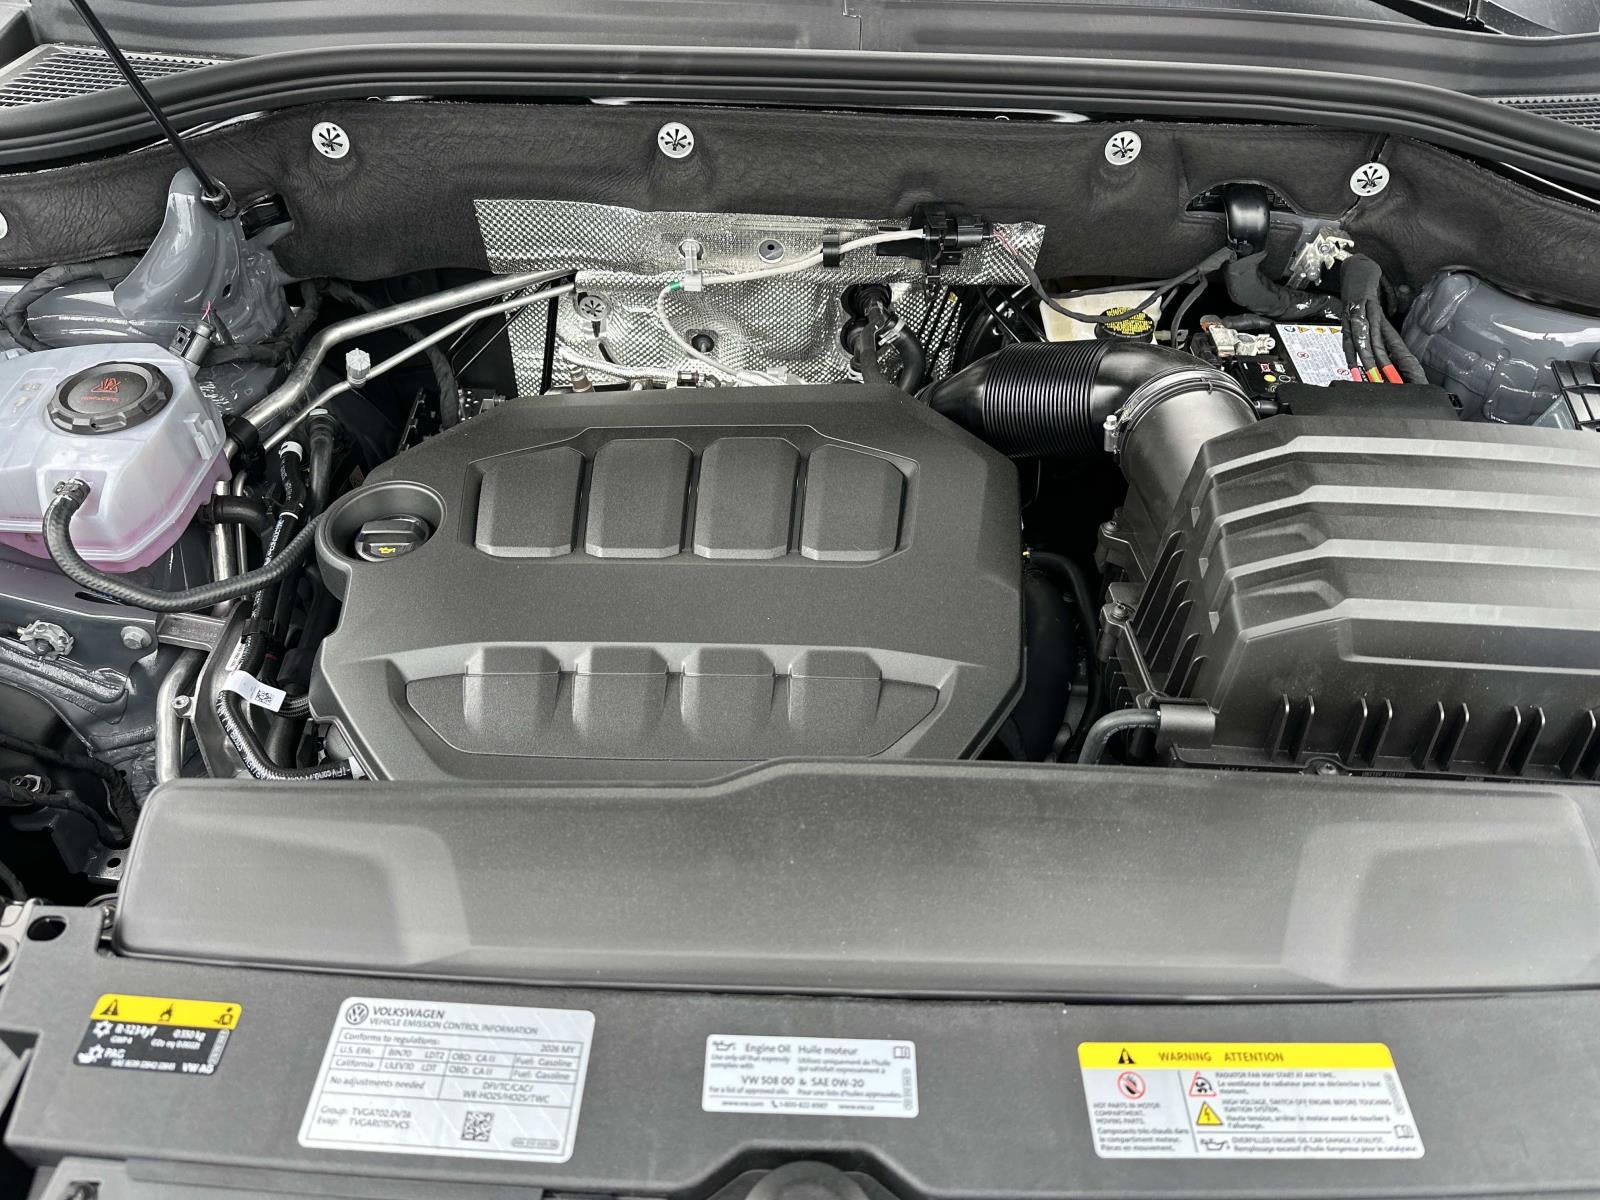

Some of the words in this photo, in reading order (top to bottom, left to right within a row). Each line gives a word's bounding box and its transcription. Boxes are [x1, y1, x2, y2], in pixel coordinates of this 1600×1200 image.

[372, 1006, 445, 1020] VOLKSWAGEN
[369, 1018, 401, 1027] VEHICLE
[402, 1019, 441, 1030] EMISSION
[442, 1021, 480, 1032] CONTROL
[481, 1023, 538, 1035] INFORMATION
[344, 1032, 381, 1043] Conforms
[383, 1034, 392, 1043] to
[746, 1043, 776, 1055] Engine
[777, 1044, 790, 1053] Oil
[798, 1046, 822, 1054] Huile
[824, 1046, 858, 1055] moteur
[424, 1050, 445, 1060] LDT2
[1158, 1052, 1212, 1062] WARNING
[1224, 1052, 1284, 1062] ATTENTION
[538, 1058, 572, 1068] Gasoline
[535, 1070, 570, 1080] Gasoline
[330, 1076, 342, 1084] No
[343, 1077, 392, 1090] adjustments
[393, 1080, 425, 1090] needed
[742, 1076, 758, 1084] VW
[761, 1076, 778, 1085] 508
[781, 1076, 795, 1086] 00
[811, 1077, 829, 1086] SAE
